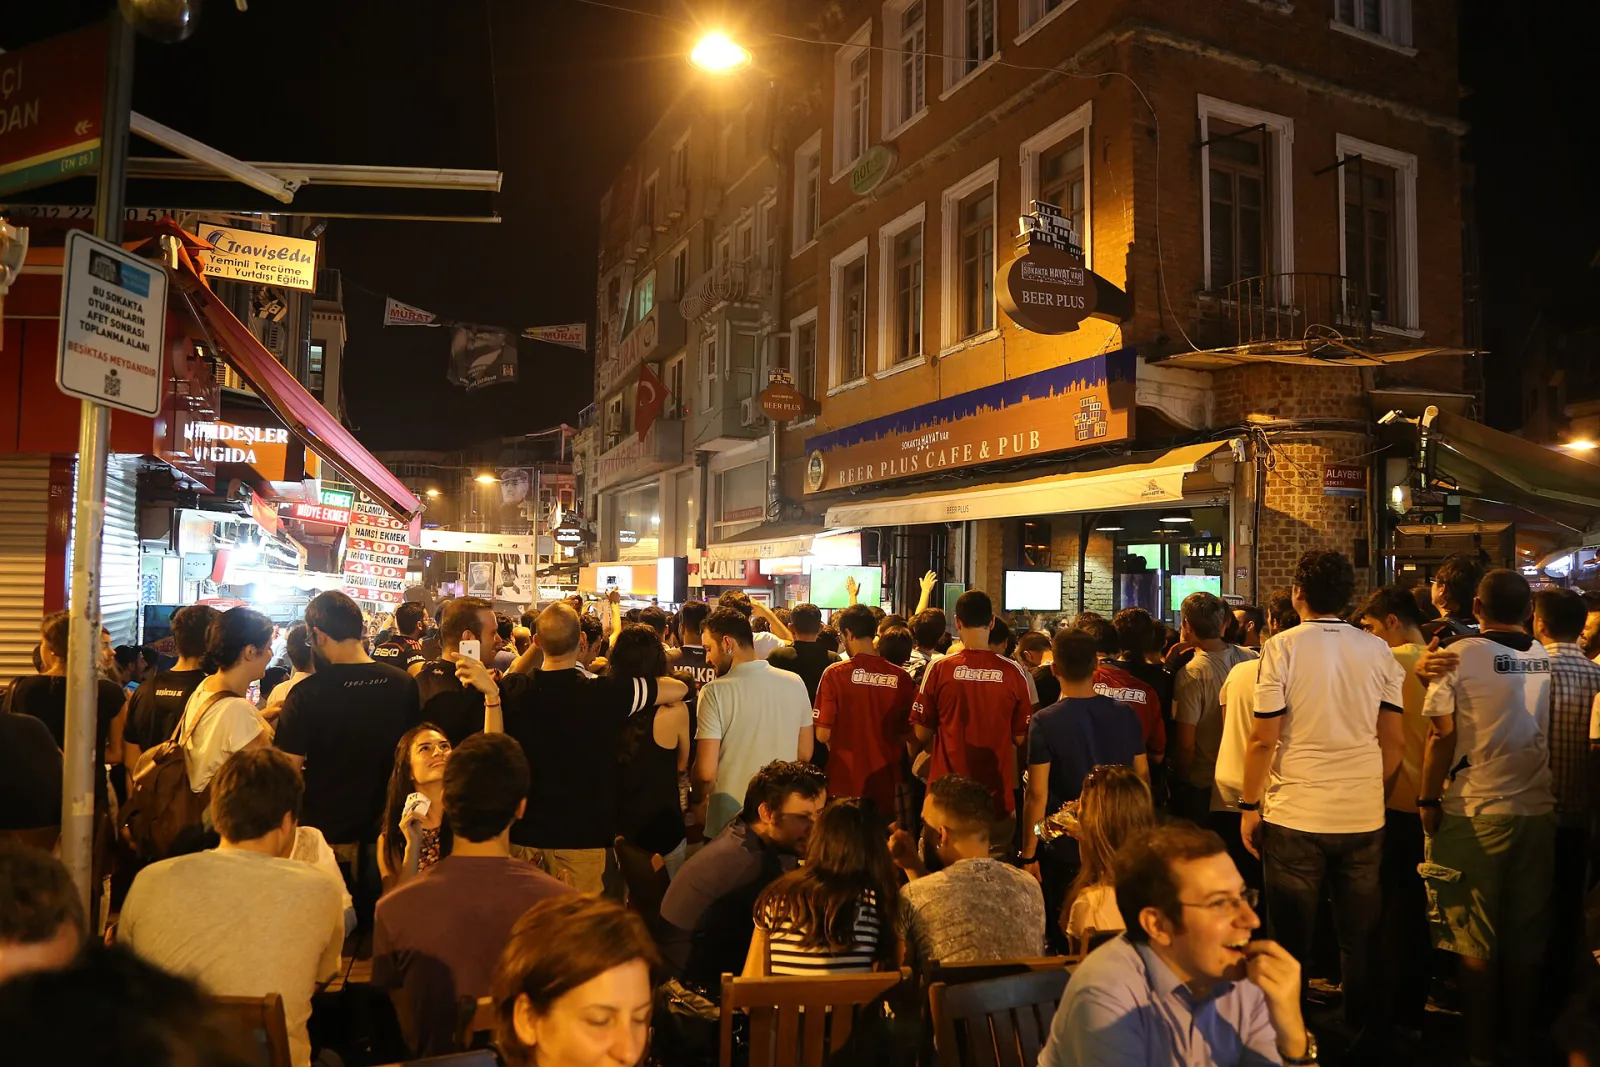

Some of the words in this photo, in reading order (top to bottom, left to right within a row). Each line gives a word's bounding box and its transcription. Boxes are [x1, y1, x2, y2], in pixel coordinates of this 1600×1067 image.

[228, 240, 311, 264] TravisEdu
[210, 255, 250, 268] Yeminli
[255, 261, 301, 275] Tercüme
[1049, 267, 1070, 279] HAYAT
[1071, 271, 1082, 280] VAR
[204, 264, 222, 273] ize
[235, 268, 273, 281] Yurtdışı
[277, 275, 309, 286] Eğitim
[93, 285, 105, 298] BU
[106, 289, 143, 313] SOKAKTA
[1022, 290, 1054, 306] BEER
[1056, 294, 1085, 309] PLUS
[88, 297, 146, 327] OTURANLARIN
[390, 309, 431, 322] MURAT
[87, 310, 108, 326] AFET
[110, 317, 145, 338] SONRASI
[79, 320, 124, 344] TOPLANMA
[126, 337, 150, 353] ALANI
[544, 332, 581, 341] MURAT
[110, 354, 157, 378] MEYDANIDIR
[763, 402, 782, 410] BEER
[783, 403, 801, 411] PLUS
[920, 431, 939, 445] HAYAT
[211, 446, 257, 464] GIDA
[840, 465, 873, 484] BEER
[881, 455, 918, 477] PLUS
[926, 444, 972, 469] CAFE
[980, 440, 991, 459] &
[998, 430, 1040, 456] PUB
[297, 504, 321, 520] MİDYE
[322, 508, 349, 523] EKMEK
[946, 505, 957, 515] BEER
[958, 504, 969, 513] PLUS
[380, 531, 406, 543] EKMEK
[375, 555, 404, 566] EKMEK
[701, 557, 745, 580] ECZANE
[379, 579, 402, 591] EKMEK
[374, 647, 400, 657] BEKO
[953, 665, 1003, 682] ÜLKER
[1494, 654, 1550, 674] ÜLKER
[852, 668, 899, 688] ÜLKER
[1093, 682, 1146, 704] ÜLKER
